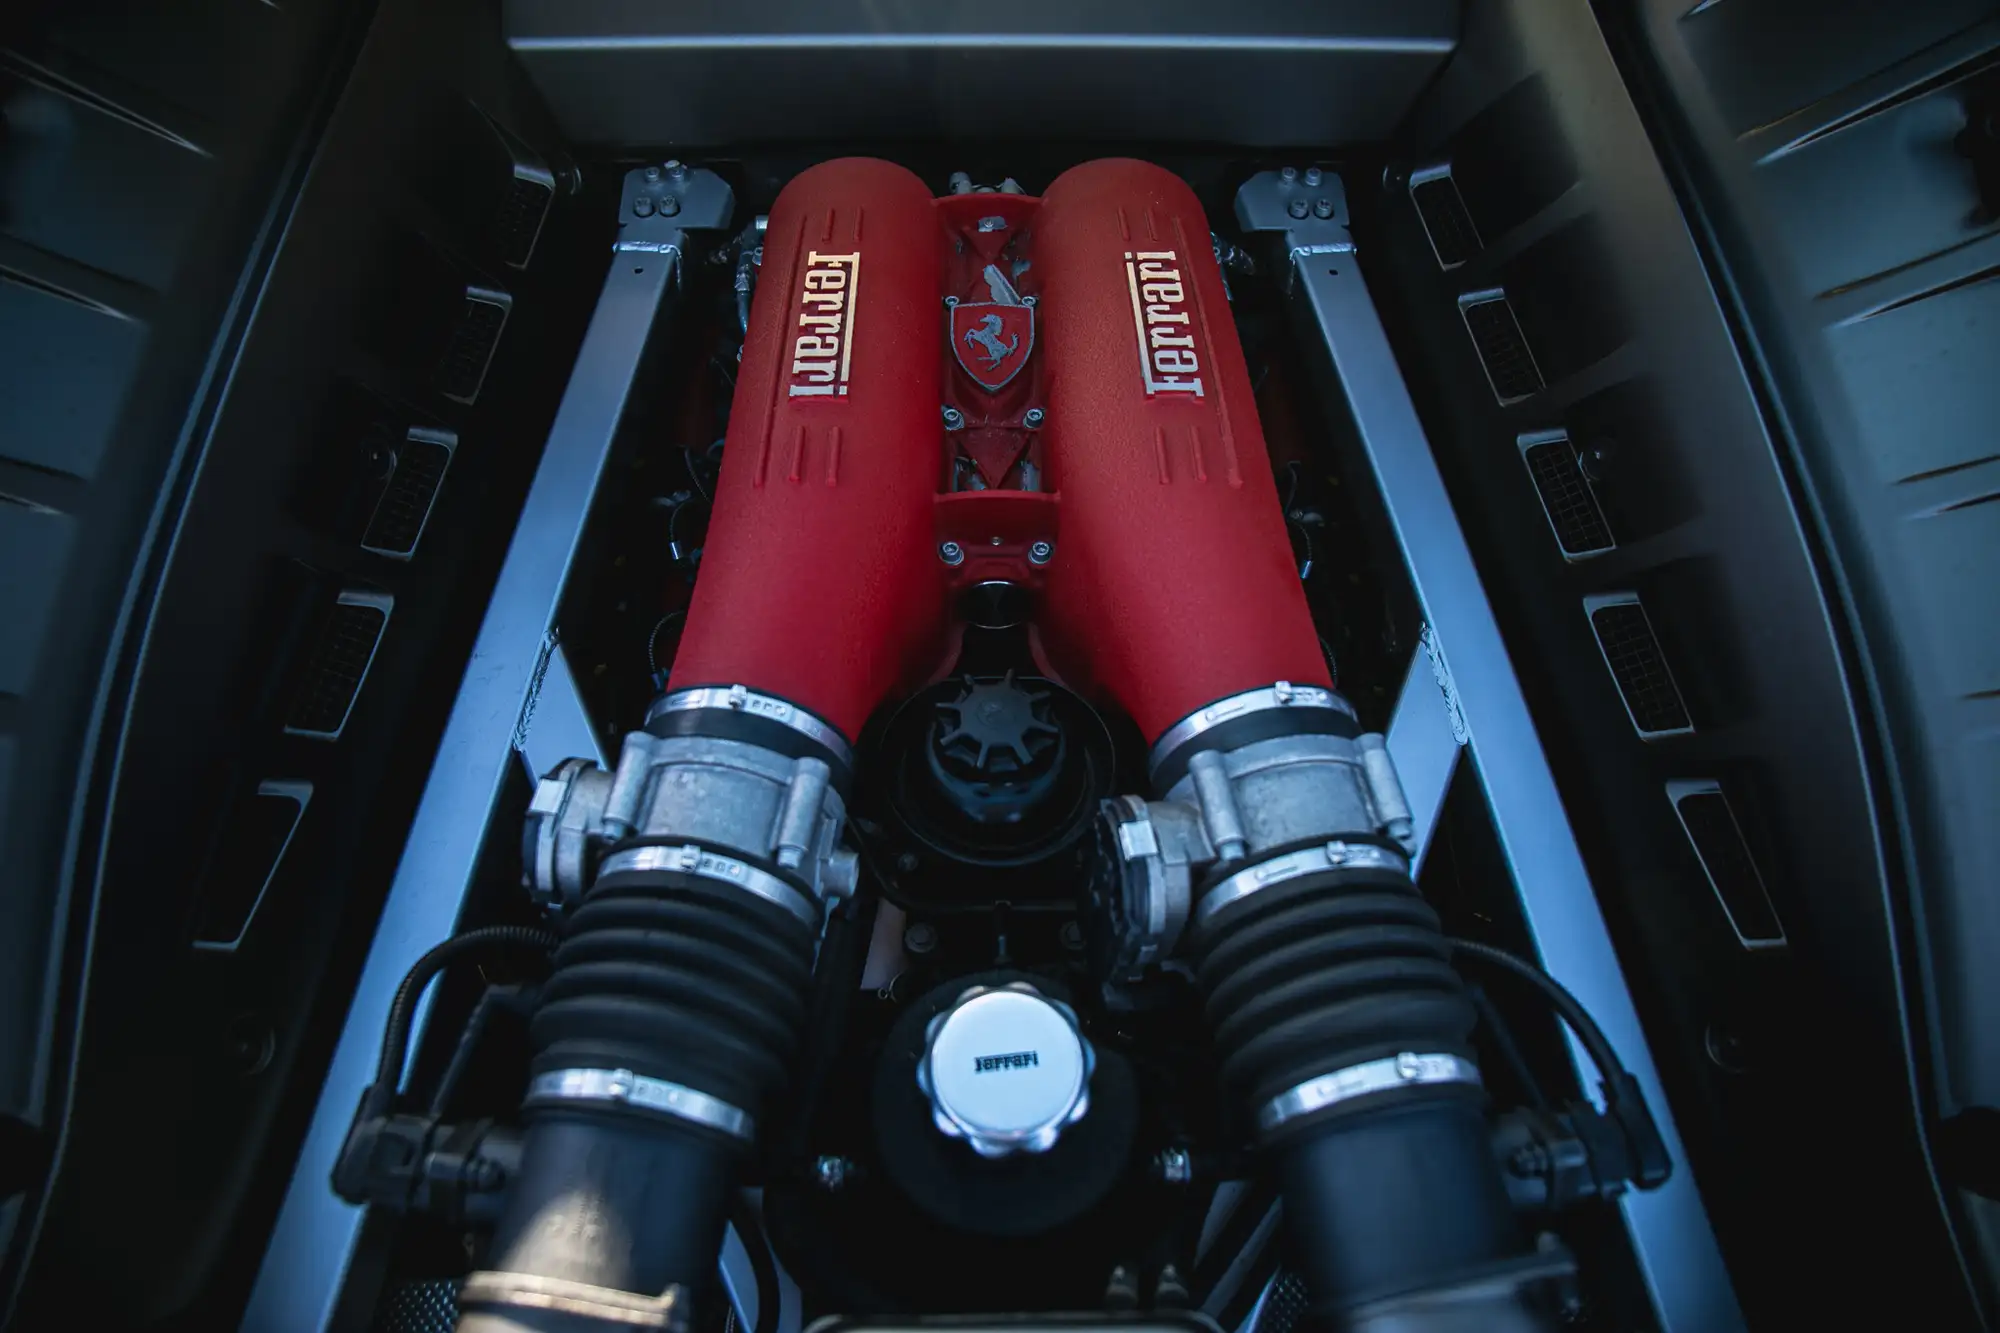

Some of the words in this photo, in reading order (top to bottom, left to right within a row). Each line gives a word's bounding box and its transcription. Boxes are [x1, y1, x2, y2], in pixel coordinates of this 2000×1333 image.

[789, 251, 860, 396] Ferrari
[1124, 251, 1204, 396] Ferrari
[974, 1050, 1039, 1073] Ferrari
